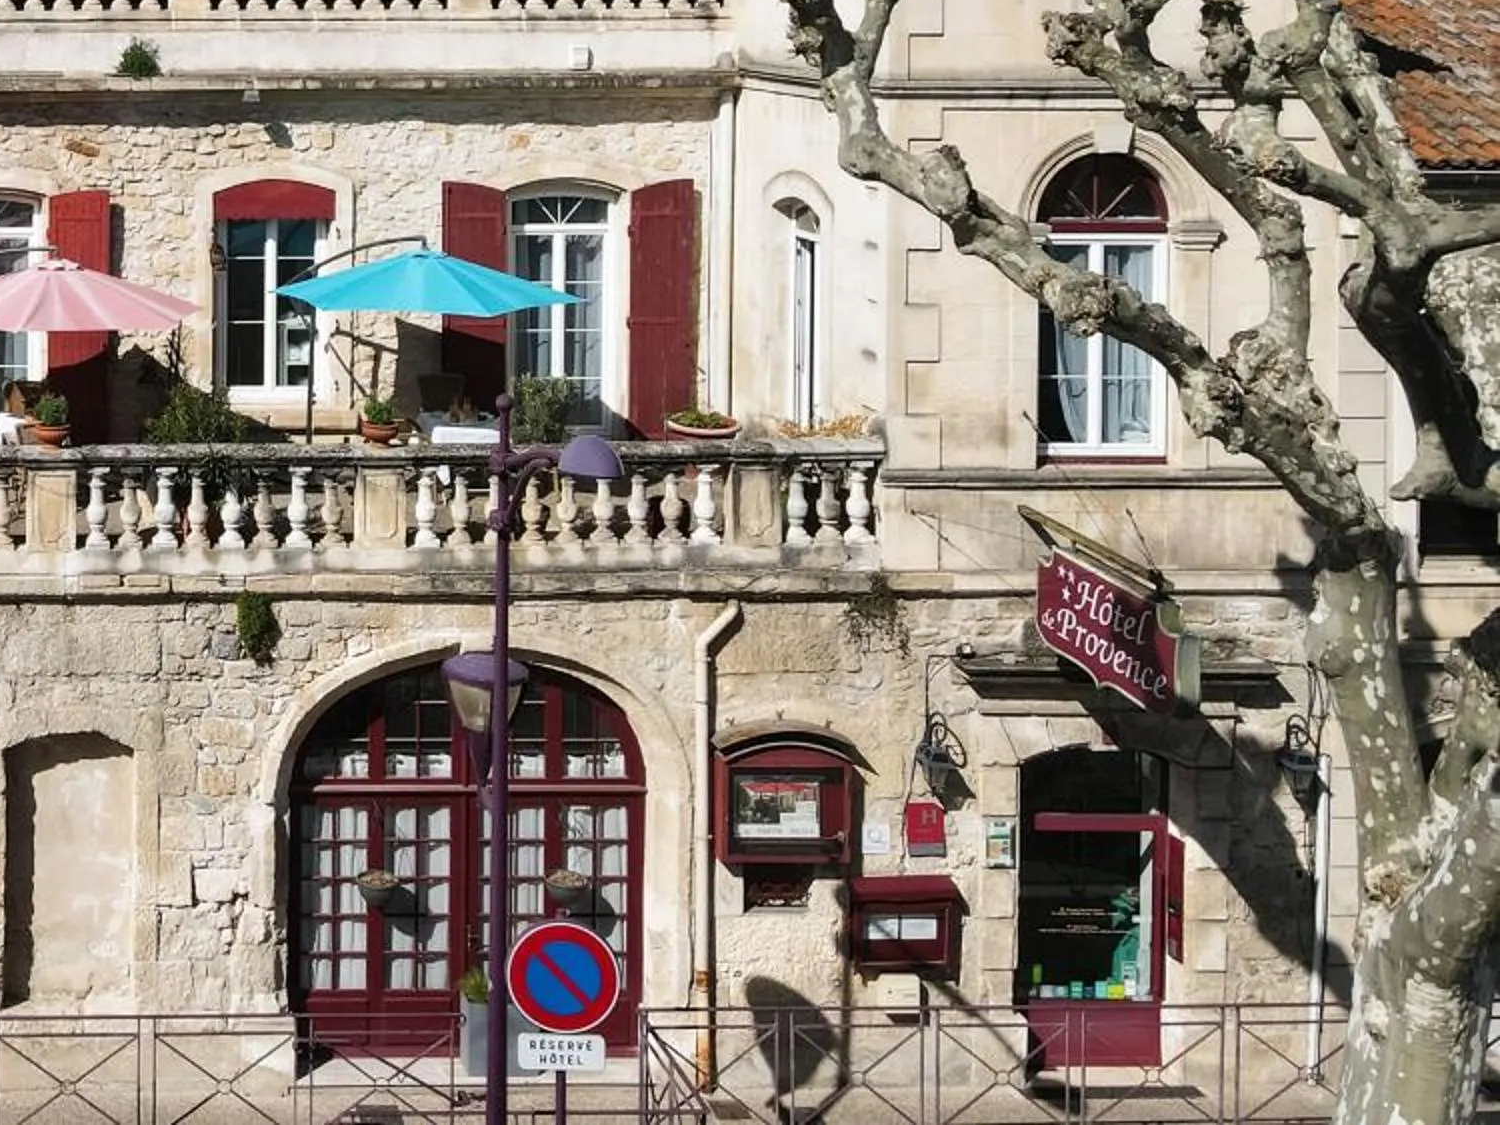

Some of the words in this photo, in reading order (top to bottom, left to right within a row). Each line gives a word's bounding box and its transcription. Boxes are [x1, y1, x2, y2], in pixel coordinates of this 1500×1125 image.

[1074, 580, 1153, 645] Hôtel
[1041, 608, 1055, 630] de
[1056, 608, 1168, 699] Provence
[921, 809, 937, 825] H
[539, 1053, 584, 1066] HÔTEL
